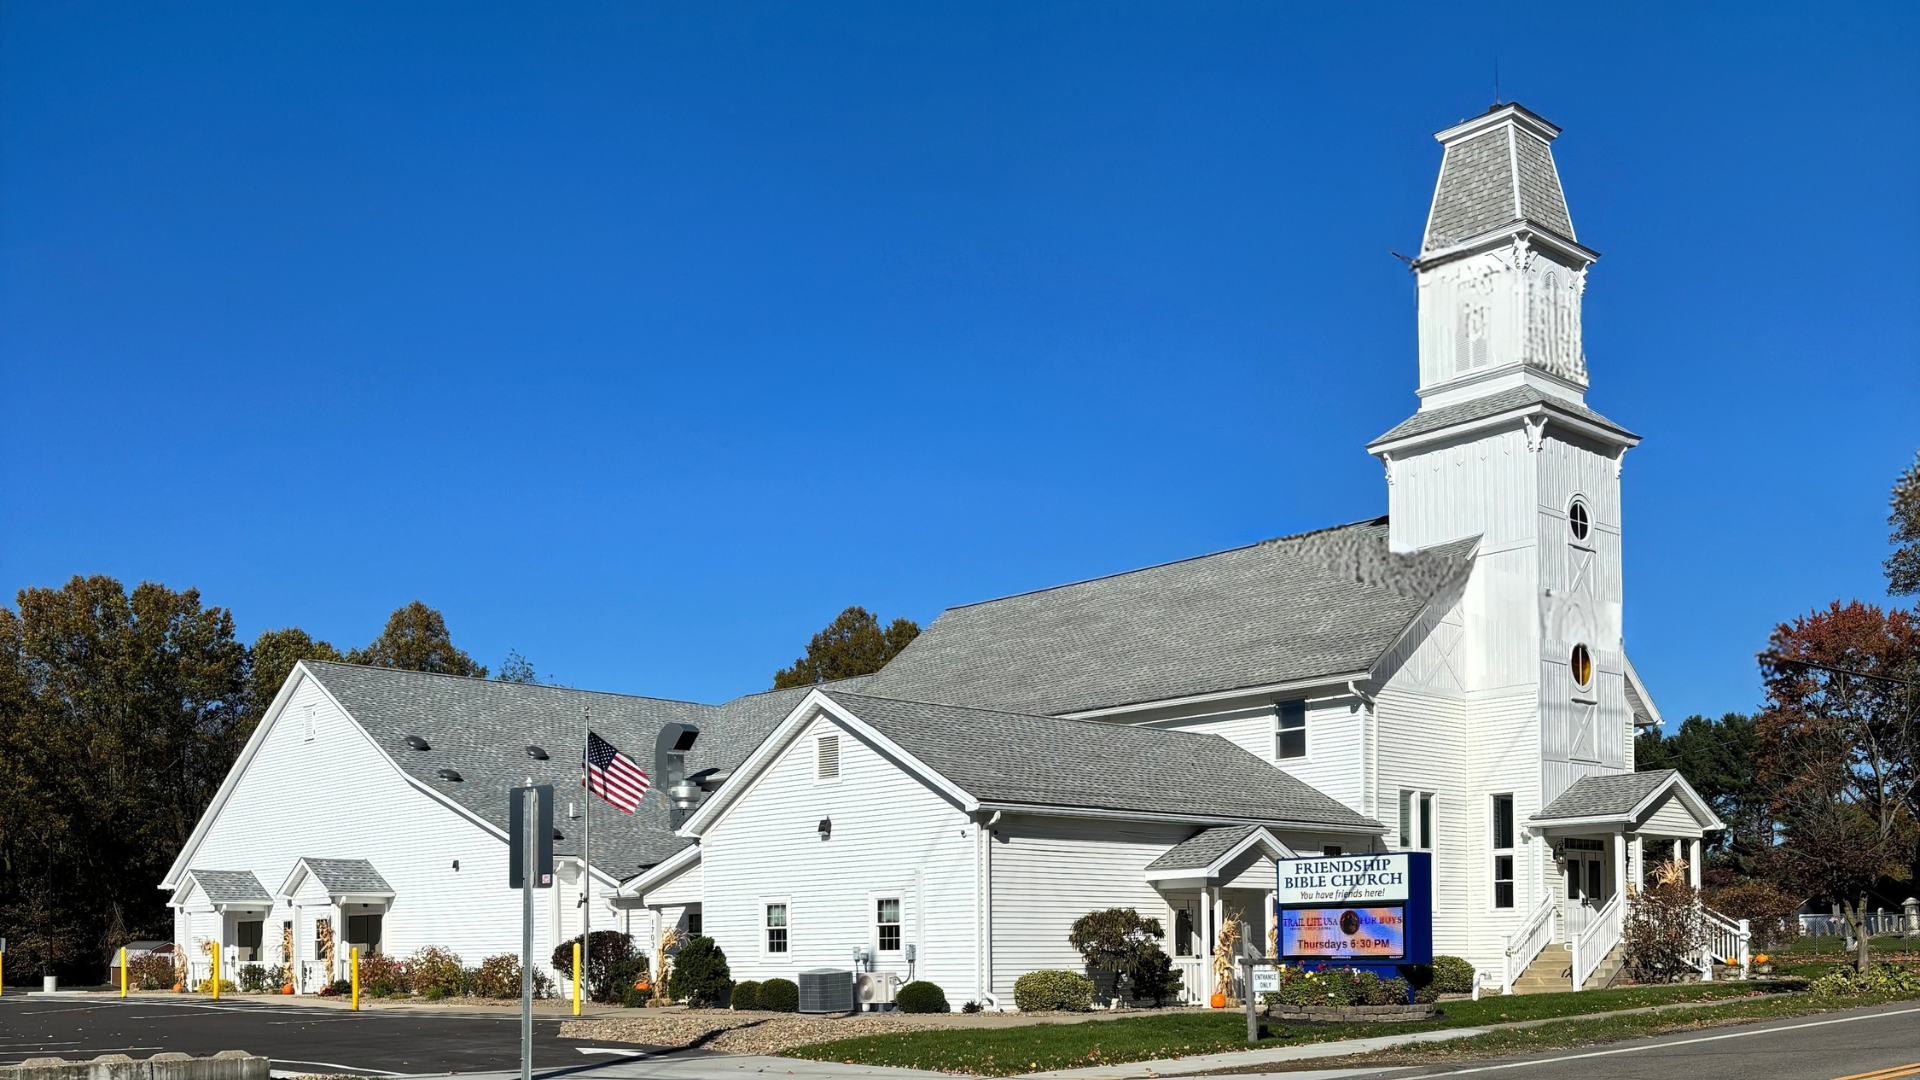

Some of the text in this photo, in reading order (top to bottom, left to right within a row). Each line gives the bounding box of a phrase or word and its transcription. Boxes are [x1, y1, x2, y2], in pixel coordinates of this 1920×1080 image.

[1295, 859, 1391, 874] FRIENDSHIP
[1285, 872, 1403, 889] BIBLE CHURCH
[1300, 888, 1386, 900] You have friends here!
[1283, 918, 1305, 927] TRAIL
[1306, 917, 1323, 927] LIFE
[1323, 917, 1339, 926] USA
[1379, 915, 1403, 924] BOYS
[1297, 939, 1390, 951] Thursdays 6:30 PM
